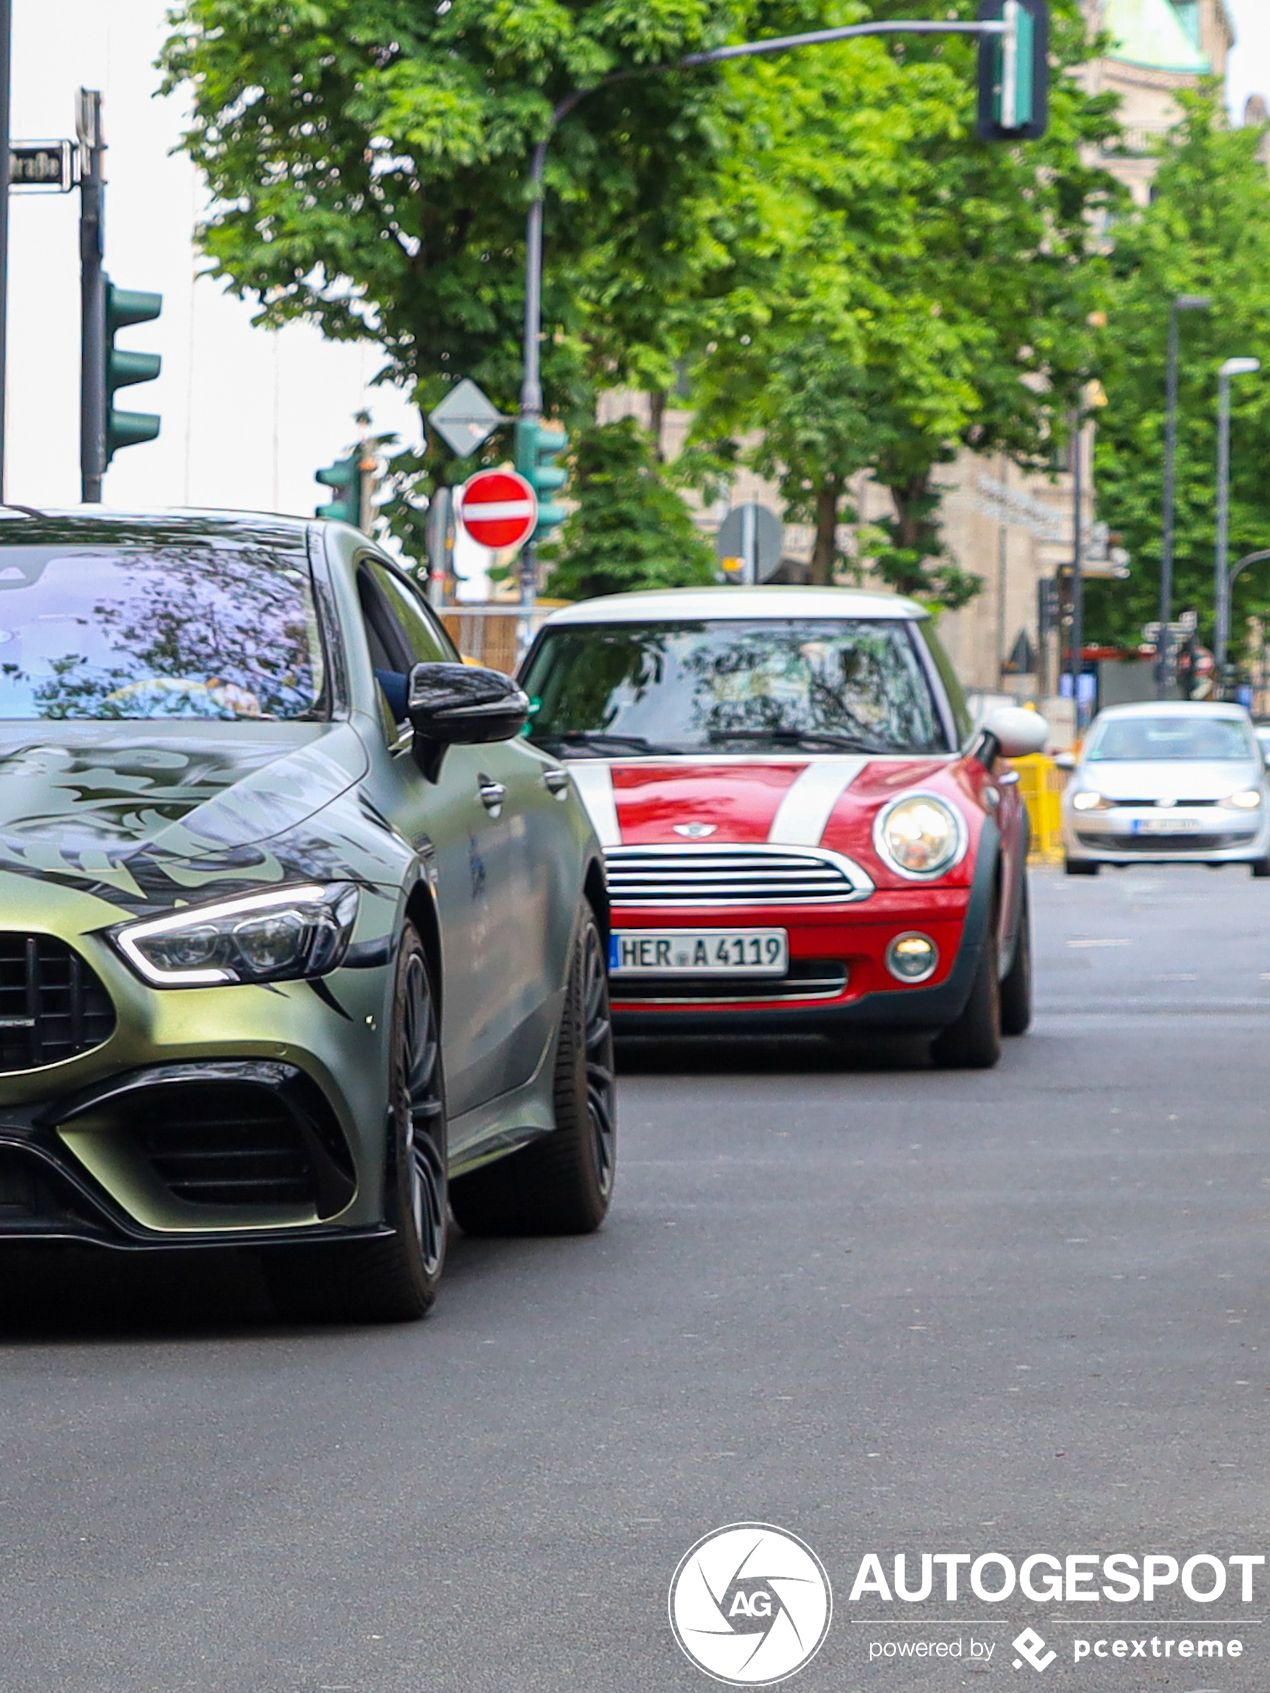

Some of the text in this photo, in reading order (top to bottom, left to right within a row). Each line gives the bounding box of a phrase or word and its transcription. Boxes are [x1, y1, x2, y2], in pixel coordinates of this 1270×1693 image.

[9, 151, 60, 179] traße
[622, 938, 781, 966] HER A 4119
